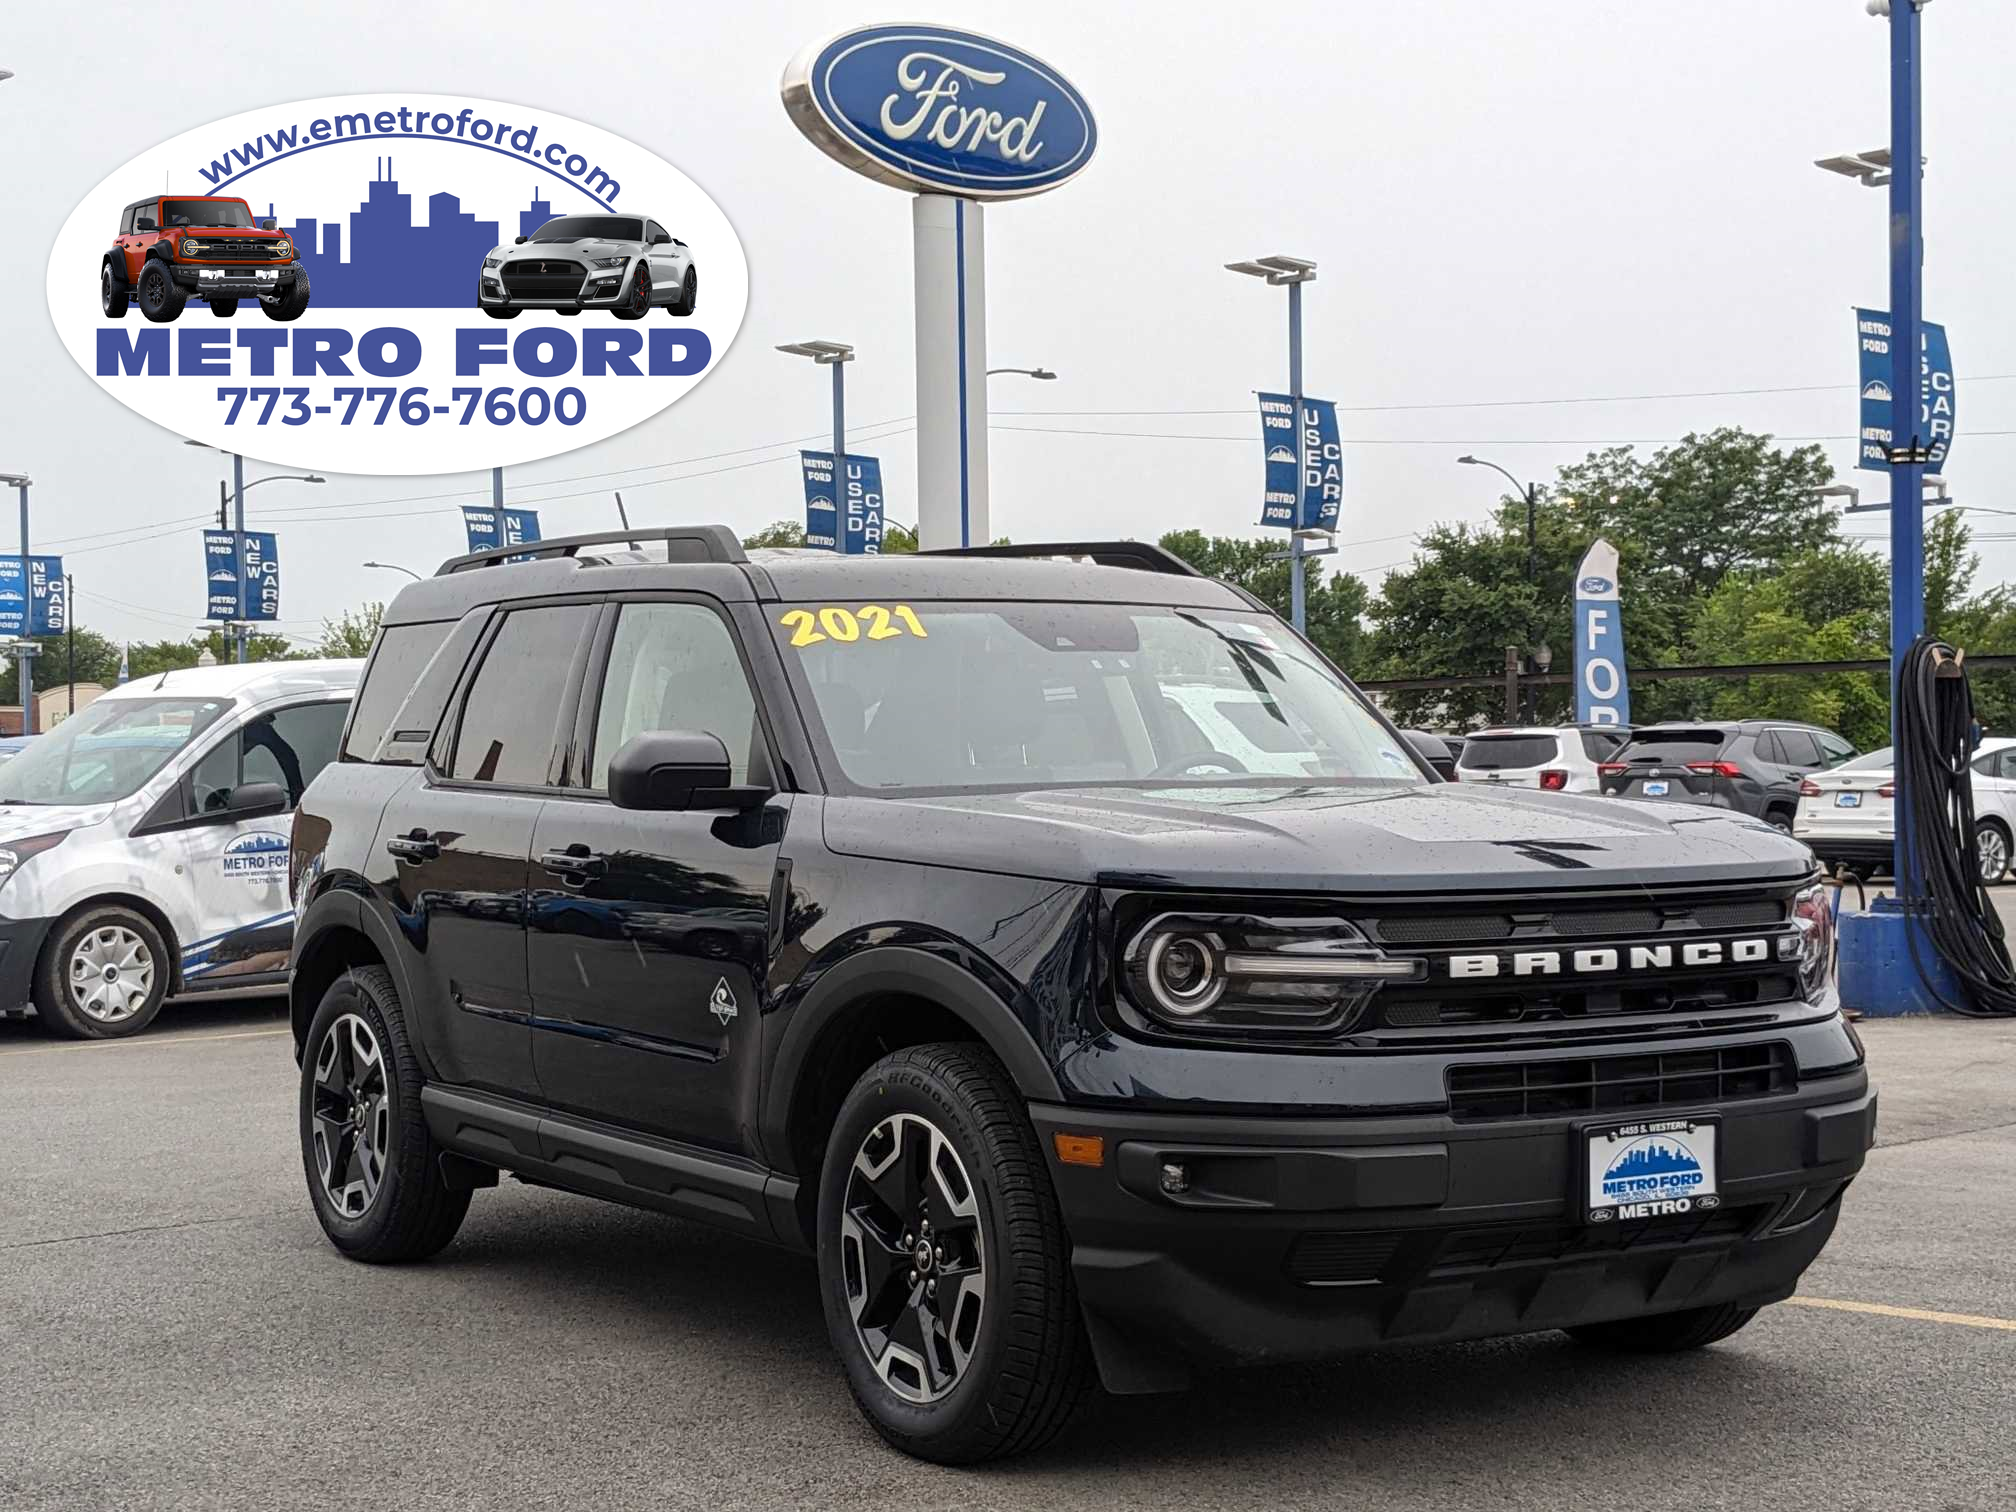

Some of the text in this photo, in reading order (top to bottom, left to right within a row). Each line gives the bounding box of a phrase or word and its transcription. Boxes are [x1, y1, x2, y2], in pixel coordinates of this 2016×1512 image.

[880, 52, 1047, 163] Ford
[1860, 321, 1891, 336] METRO
[1863, 339, 1888, 354] FORD
[1261, 401, 1293, 415] METRO
[1265, 417, 1292, 429] FORD
[1928, 372, 1951, 462] CARS
[1862, 427, 1892, 442] METRO
[1304, 408, 1322, 487] USED
[1863, 445, 1886, 460] FOR
[803, 458, 834, 470] METRO
[807, 471, 832, 482] FORD
[1320, 443, 1341, 518] CARS
[847, 464, 863, 532] USED
[1265, 491, 1296, 505] METRO
[465, 512, 495, 523] METRO
[1266, 507, 1292, 520] FORD
[470, 524, 494, 533] FORD
[864, 494, 880, 555] CARS
[205, 536, 234, 545] METRO
[806, 535, 835, 547] METRO
[209, 546, 232, 555] FORD
[246, 539, 261, 579] NEW
[32, 562, 47, 598] NEW
[262, 562, 278, 614] CARS
[48, 581, 63, 629] CARS
[210, 596, 237, 605] METRO
[211, 606, 234, 615] FORD
[780, 605, 928, 647] 2021
[224, 857, 264, 870] METRO
[1449, 939, 1768, 978] BRONCO
[1649, 1120, 1688, 1133] WESTERN
[1602, 1172, 1704, 1195] METRO FORD
[1619, 1198, 1692, 1220] METRO
